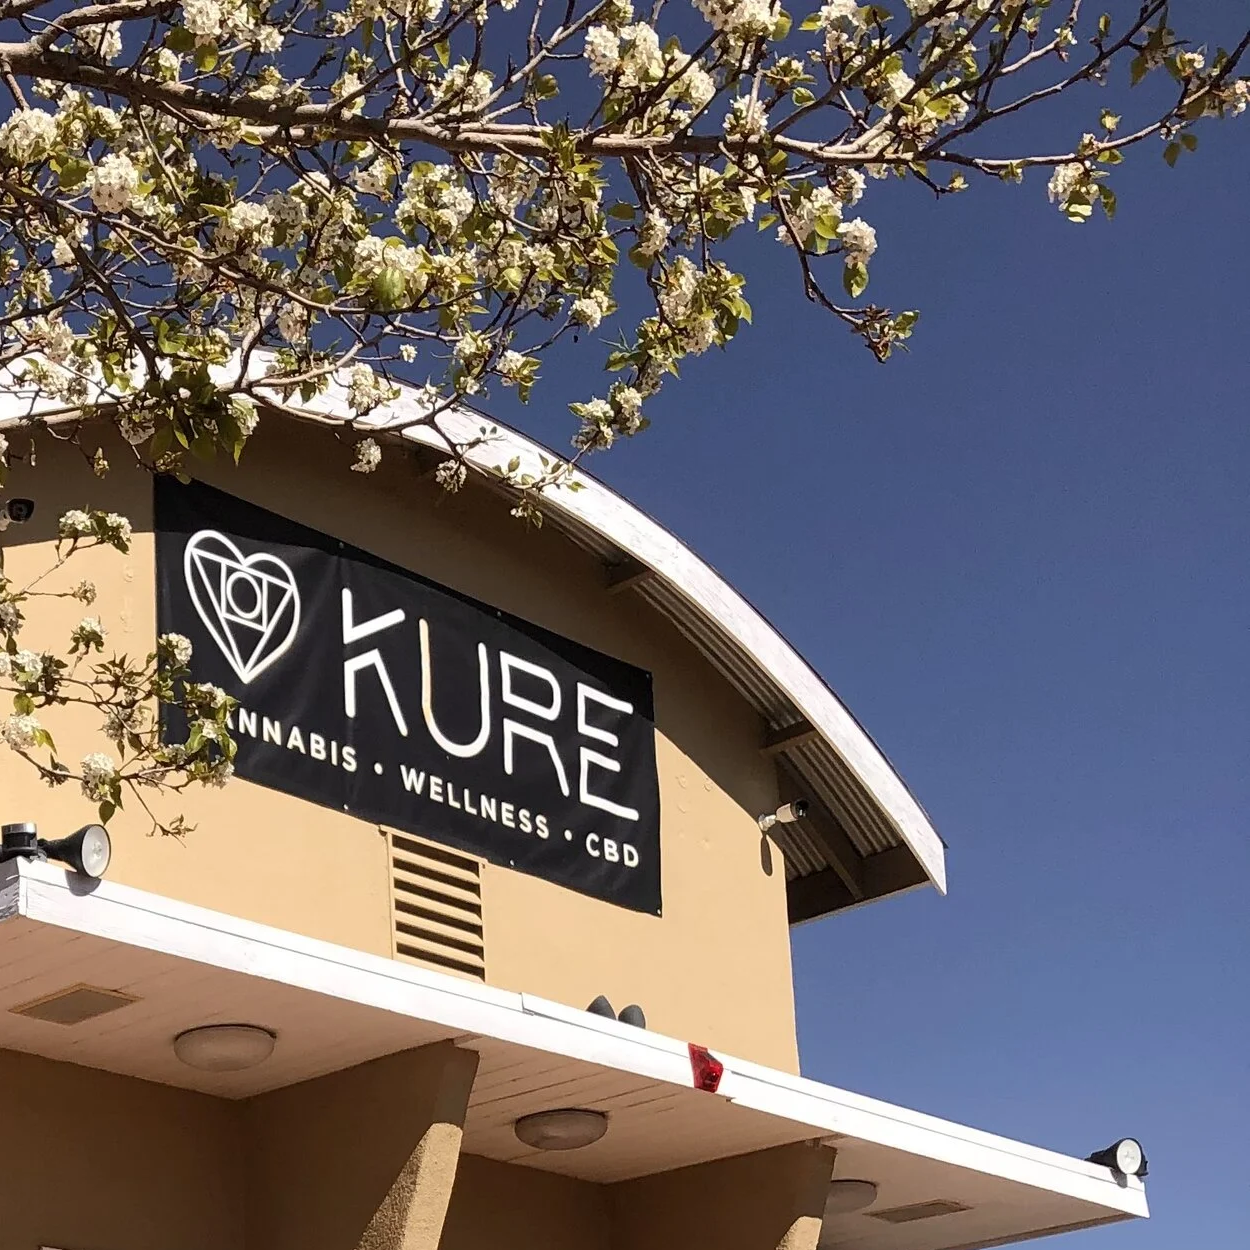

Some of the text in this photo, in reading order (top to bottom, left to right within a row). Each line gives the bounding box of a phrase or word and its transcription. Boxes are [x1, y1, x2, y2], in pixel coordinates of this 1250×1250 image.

[224, 705, 640, 868] NNABIS WELLNESS CBD
[342, 587, 640, 821] KURE
